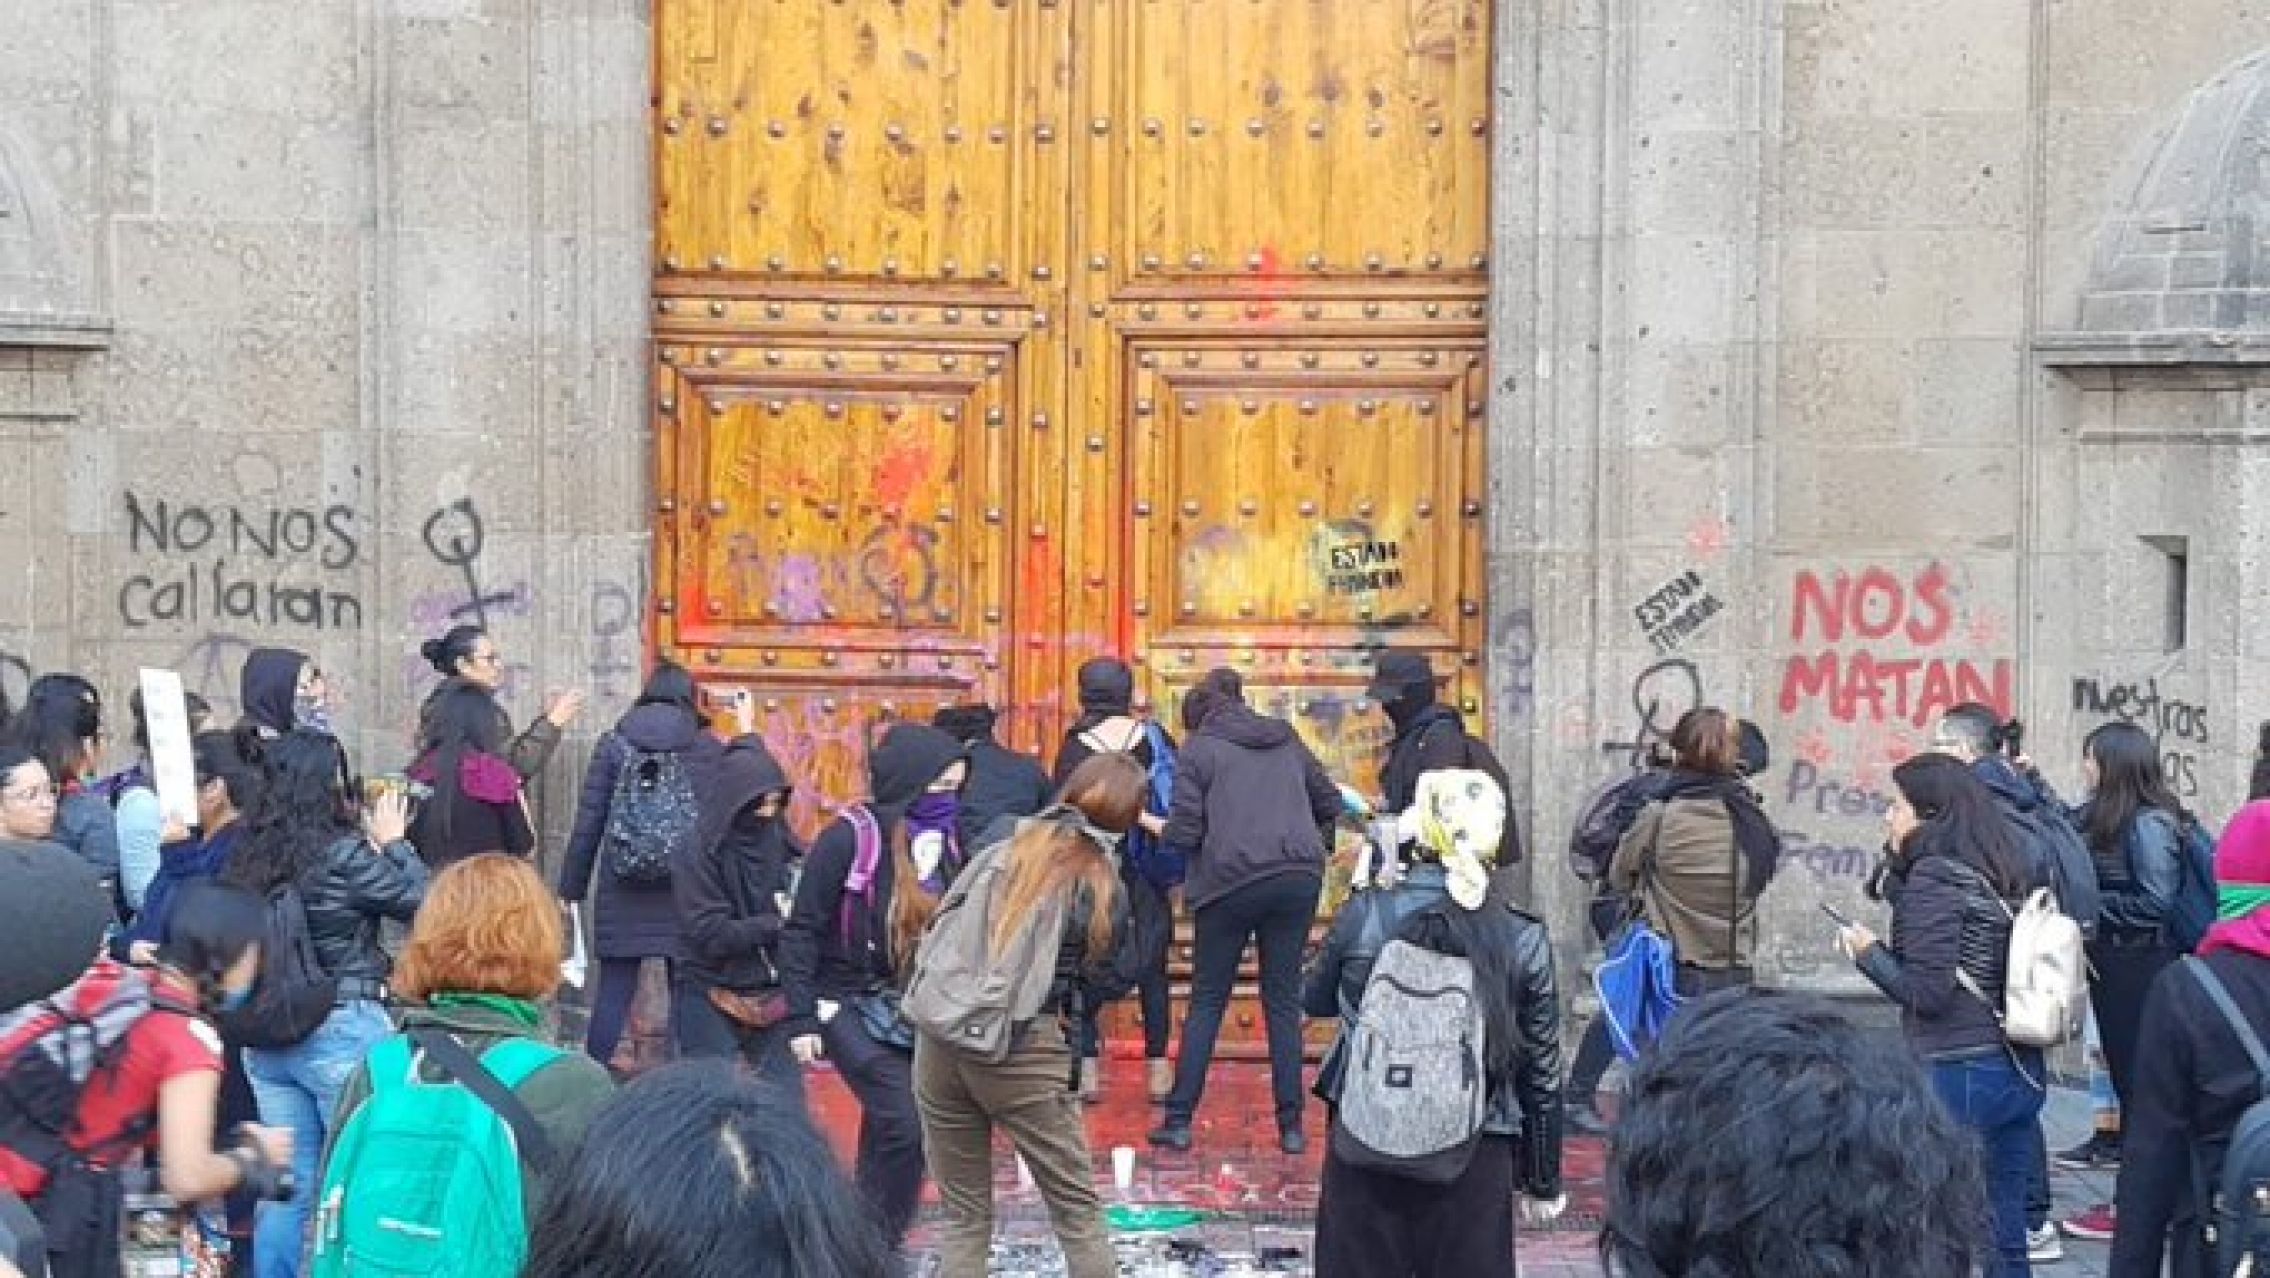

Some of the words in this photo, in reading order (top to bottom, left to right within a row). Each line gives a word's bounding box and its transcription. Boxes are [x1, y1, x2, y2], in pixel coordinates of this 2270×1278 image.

[123, 489, 214, 552] NO
[229, 504, 358, 569] NOS
[1792, 563, 1952, 646] NOS
[1779, 649, 2012, 729] MATAN
